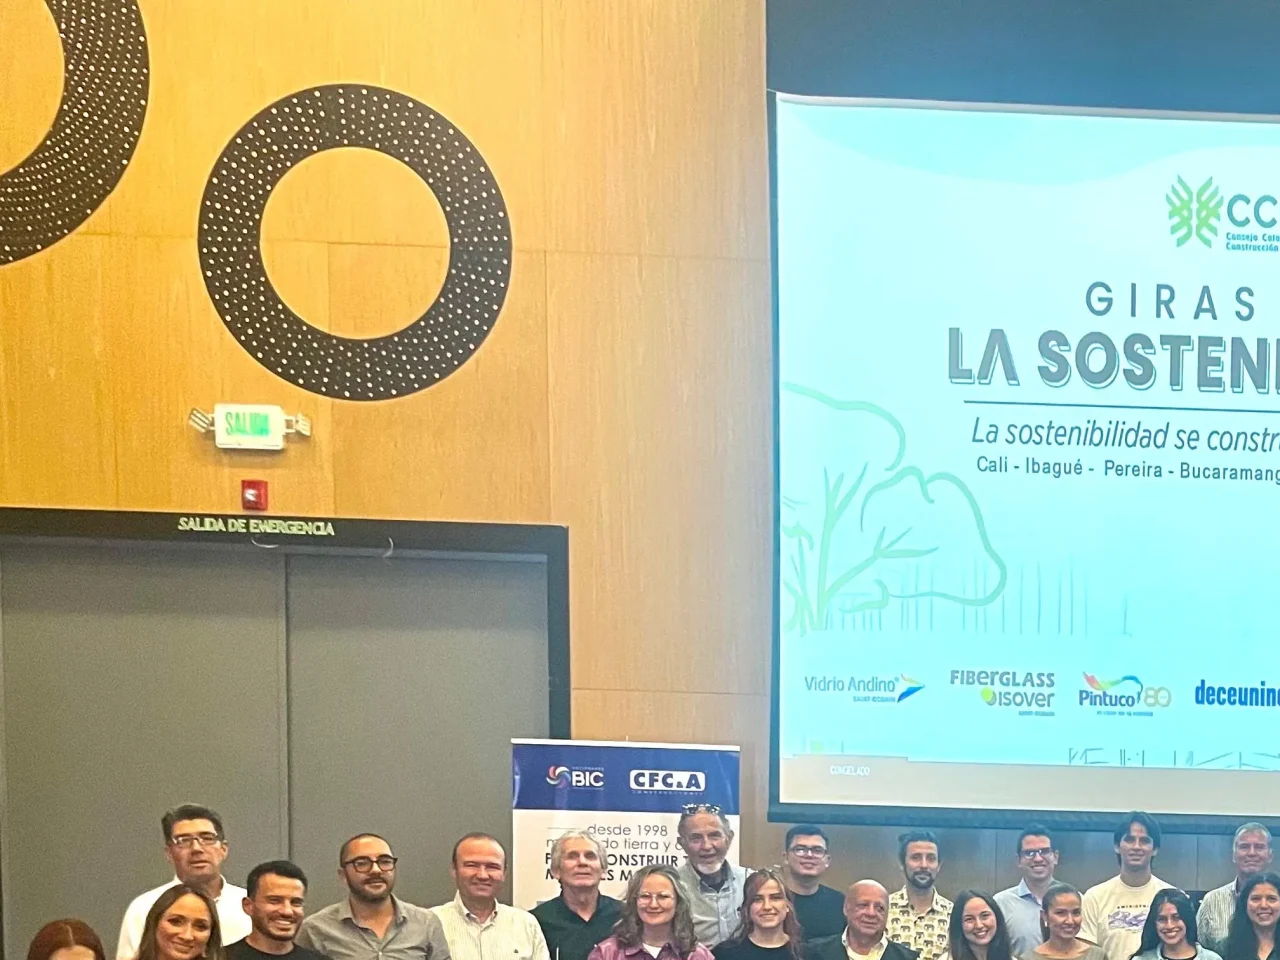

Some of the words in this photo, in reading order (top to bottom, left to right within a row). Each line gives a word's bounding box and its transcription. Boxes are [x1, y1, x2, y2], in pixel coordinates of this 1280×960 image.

[1226, 232, 1258, 242] Consejo
[1085, 281, 1255, 322] GIRAS
[948, 327, 1020, 386] LA
[225, 411, 270, 436] SALIDA
[971, 416, 999, 443] La
[1004, 420, 1170, 449] sostenibilidad
[1174, 428, 1200, 450] se
[976, 456, 1008, 472] Cali
[1025, 458, 1083, 478] Ibagué
[1104, 460, 1162, 478] Pereira
[177, 517, 226, 532] SALIDA
[228, 519, 247, 532] DE
[250, 519, 335, 536] EMERGENCIA
[804, 676, 844, 692] Vidrio
[847, 676, 896, 692] Andino
[1079, 689, 1136, 708] Pintuco
[571, 770, 604, 787] BIC
[587, 823, 631, 836] desde
[637, 825, 668, 837] 1998
[623, 839, 659, 850] tierra
[663, 842, 671, 852] y
[606, 854, 679, 867] ONSTRUIR
